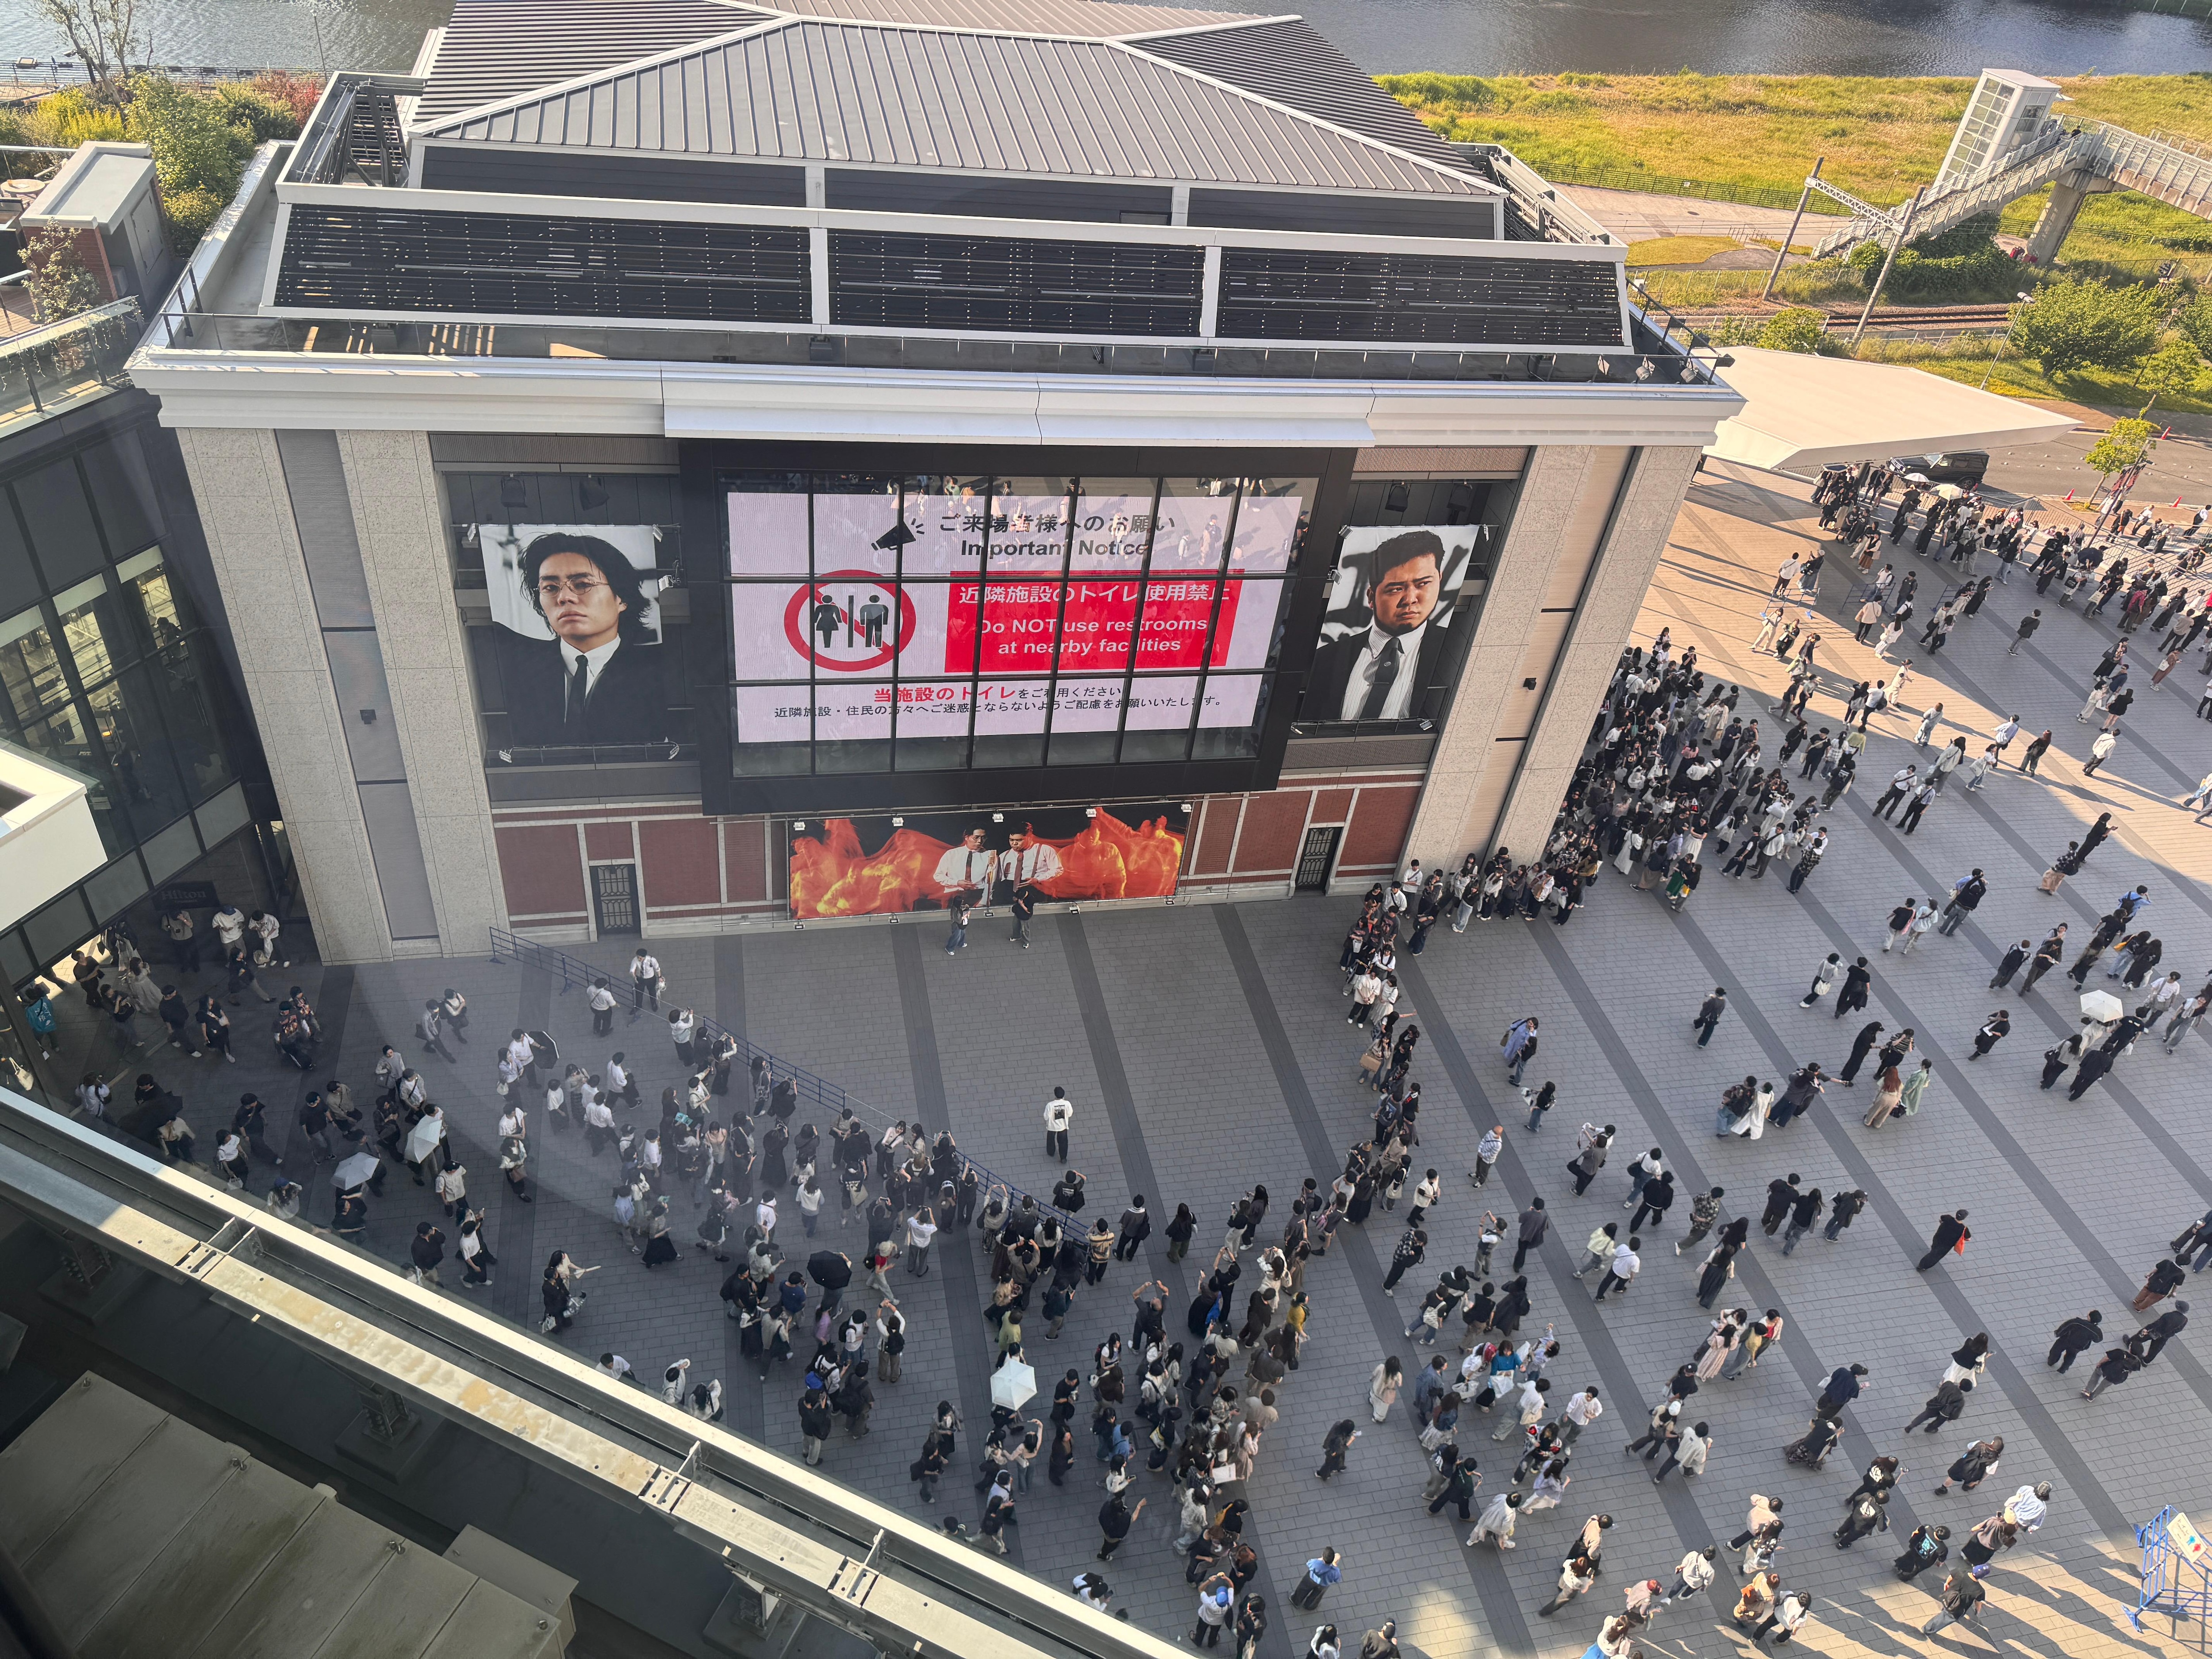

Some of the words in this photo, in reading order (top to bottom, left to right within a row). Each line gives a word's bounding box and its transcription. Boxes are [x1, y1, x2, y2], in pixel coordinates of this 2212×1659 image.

[1079, 540, 1148, 555] Notice
[1012, 619, 1056, 633] NOT
[1064, 621, 1099, 632] use
[1106, 618, 1207, 631] restrooms
[998, 641, 1017, 654] at
[1024, 640, 1093, 656] nearby
[161, 889, 207, 901] Hilton
